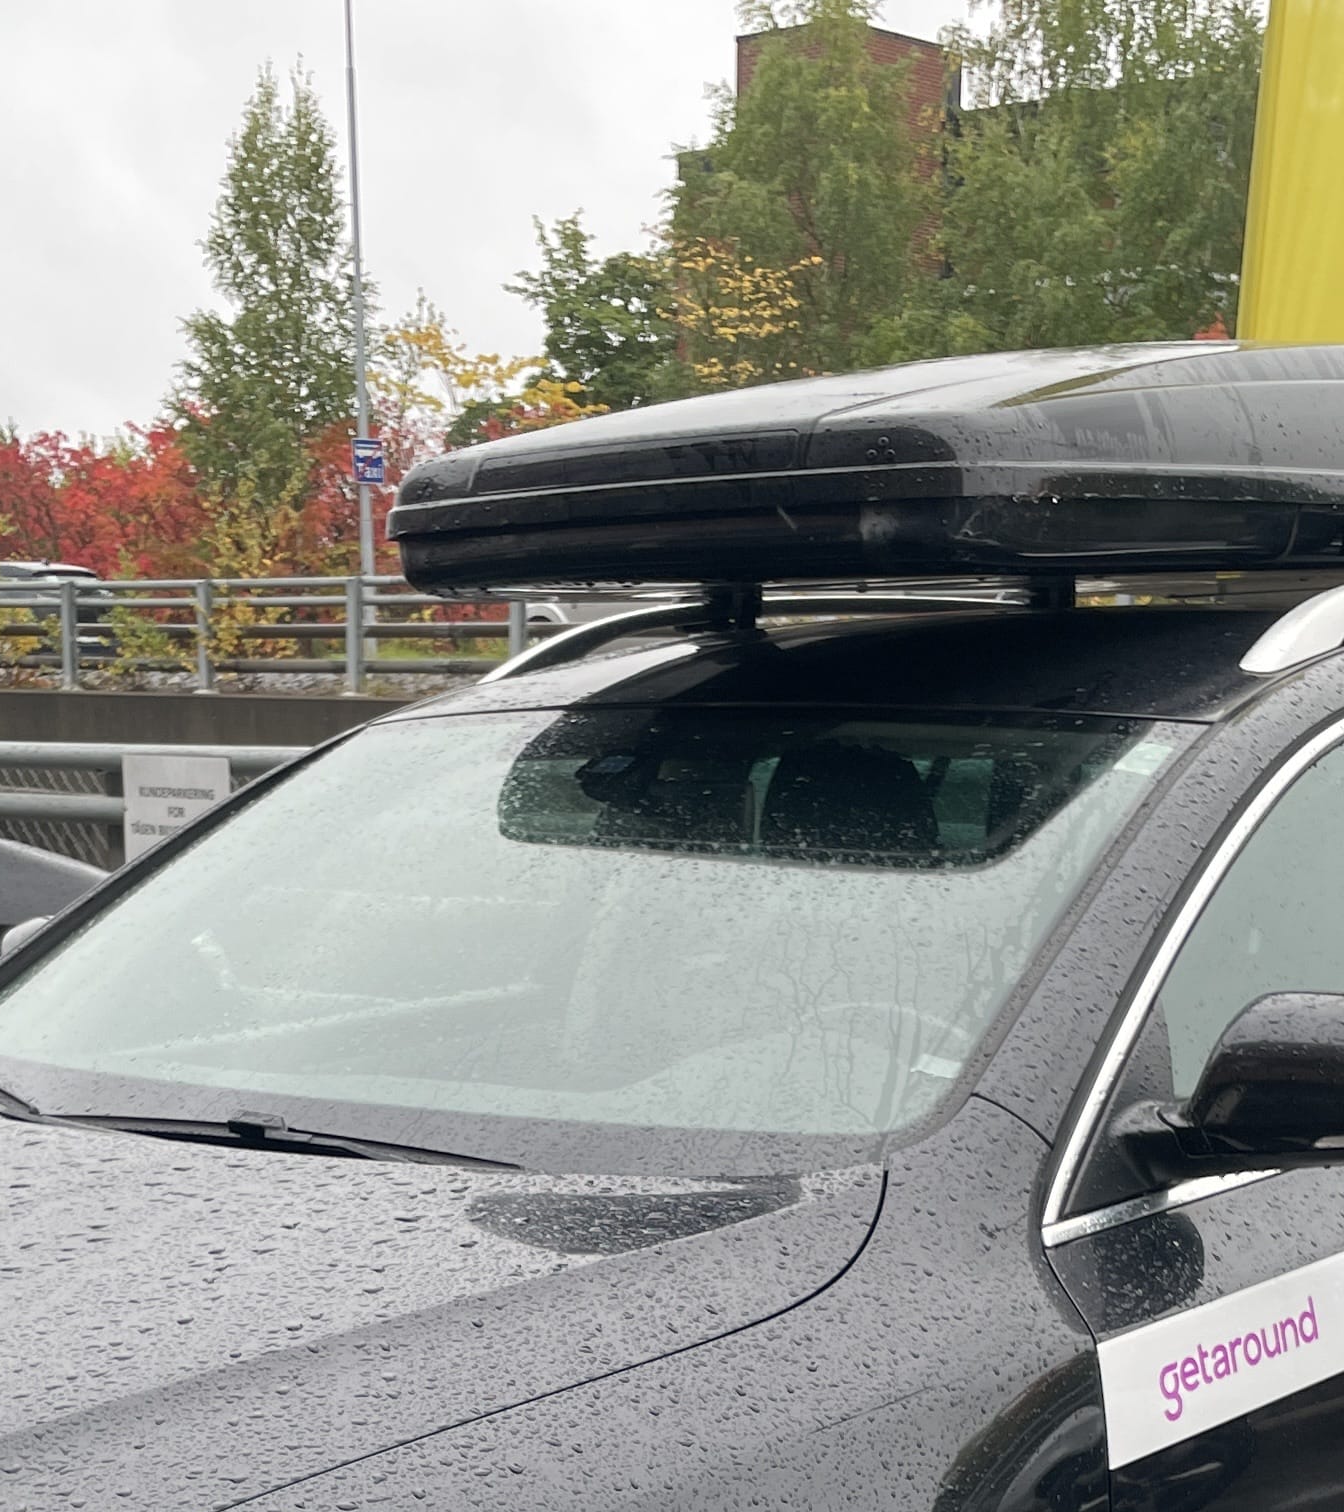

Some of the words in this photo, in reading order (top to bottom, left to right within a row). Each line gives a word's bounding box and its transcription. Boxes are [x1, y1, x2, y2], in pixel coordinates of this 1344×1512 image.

[138, 786, 216, 801] KUNDEPARKERING
[167, 806, 186, 819] FOR
[1158, 1295, 1320, 1422] getaround
